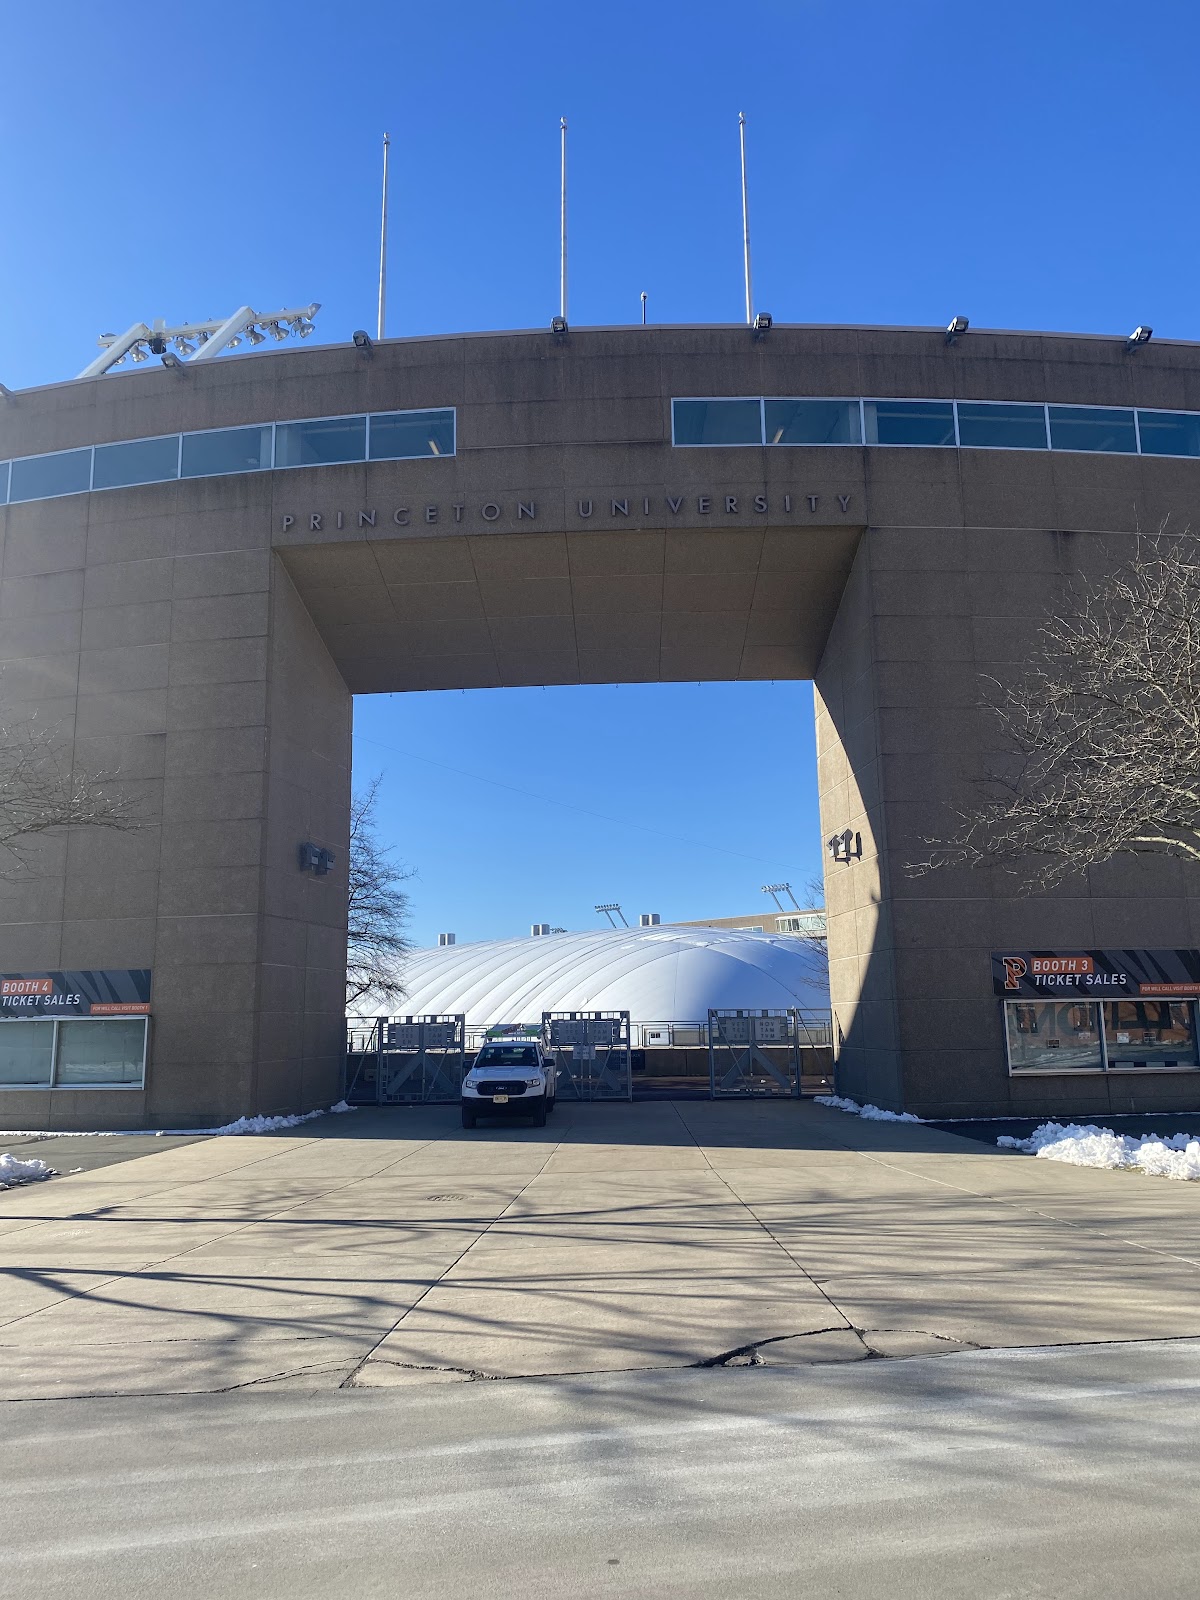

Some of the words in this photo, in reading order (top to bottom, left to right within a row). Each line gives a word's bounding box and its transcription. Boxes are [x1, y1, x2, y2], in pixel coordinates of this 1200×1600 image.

[282, 501, 536, 532] PRINCETON
[578, 494, 851, 518] UNIVERSITY
[1033, 960, 1076, 971] BOOTH
[1081, 960, 1088, 971] 3
[1034, 974, 1081, 986] TICKET
[1086, 974, 1127, 985] SALES
[2, 982, 39, 993] BOOTH
[41, 982, 49, 992] 4
[2, 995, 41, 1006] TICKET
[44, 994, 80, 1006] SALES
